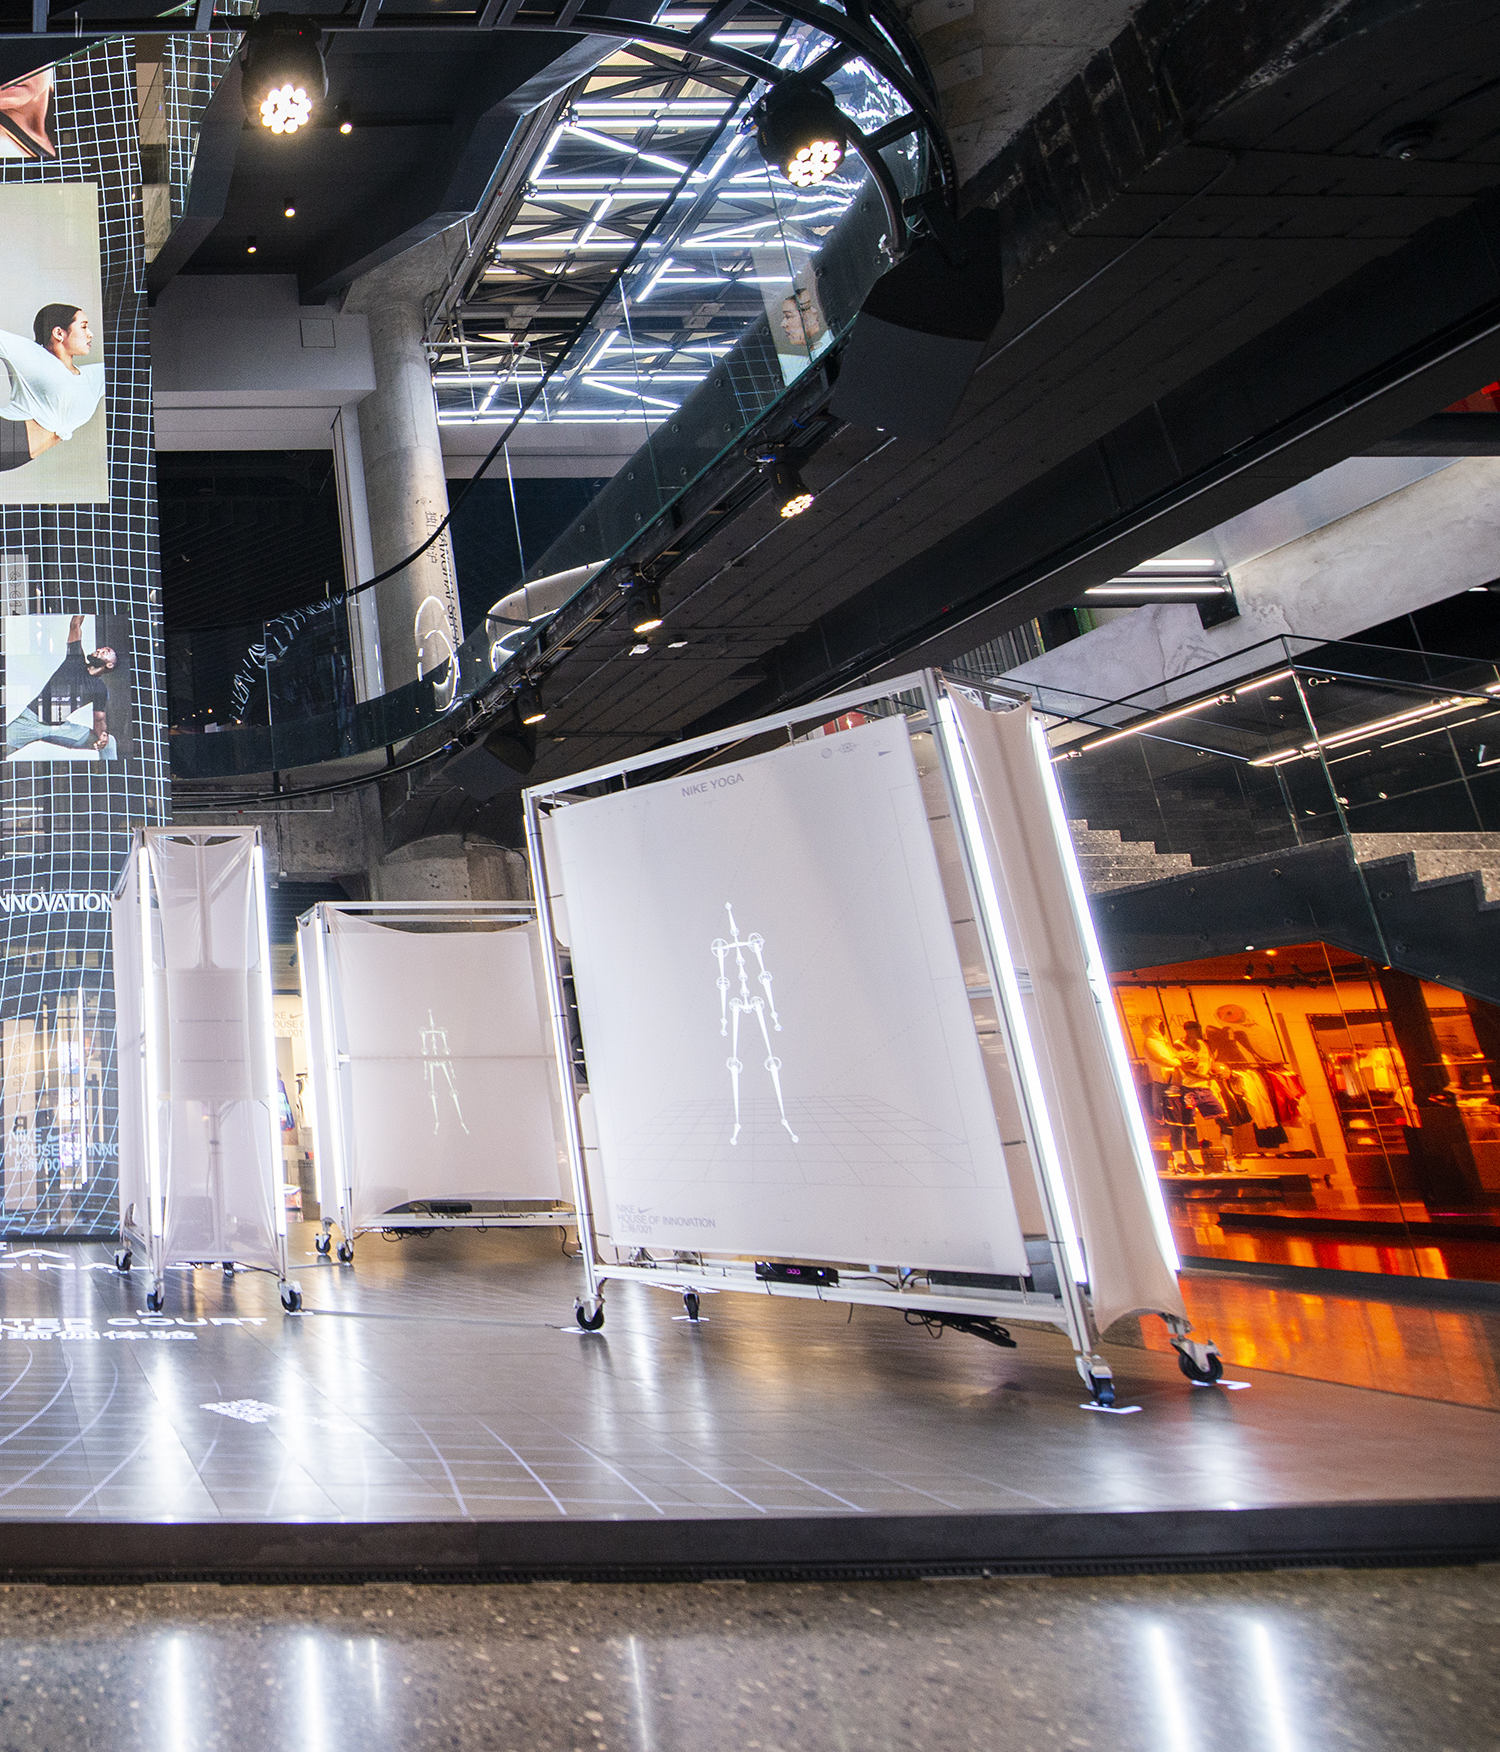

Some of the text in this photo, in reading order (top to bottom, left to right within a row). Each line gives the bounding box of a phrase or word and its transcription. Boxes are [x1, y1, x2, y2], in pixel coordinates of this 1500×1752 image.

[681, 773, 744, 797] NIKE YOGA
[9, 1129, 42, 1143] NIKE
[8, 1143, 60, 1157] HOUSE
[616, 1204, 635, 1214] NIKE
[617, 1213, 716, 1229] HOUSE OF INNOVATION
